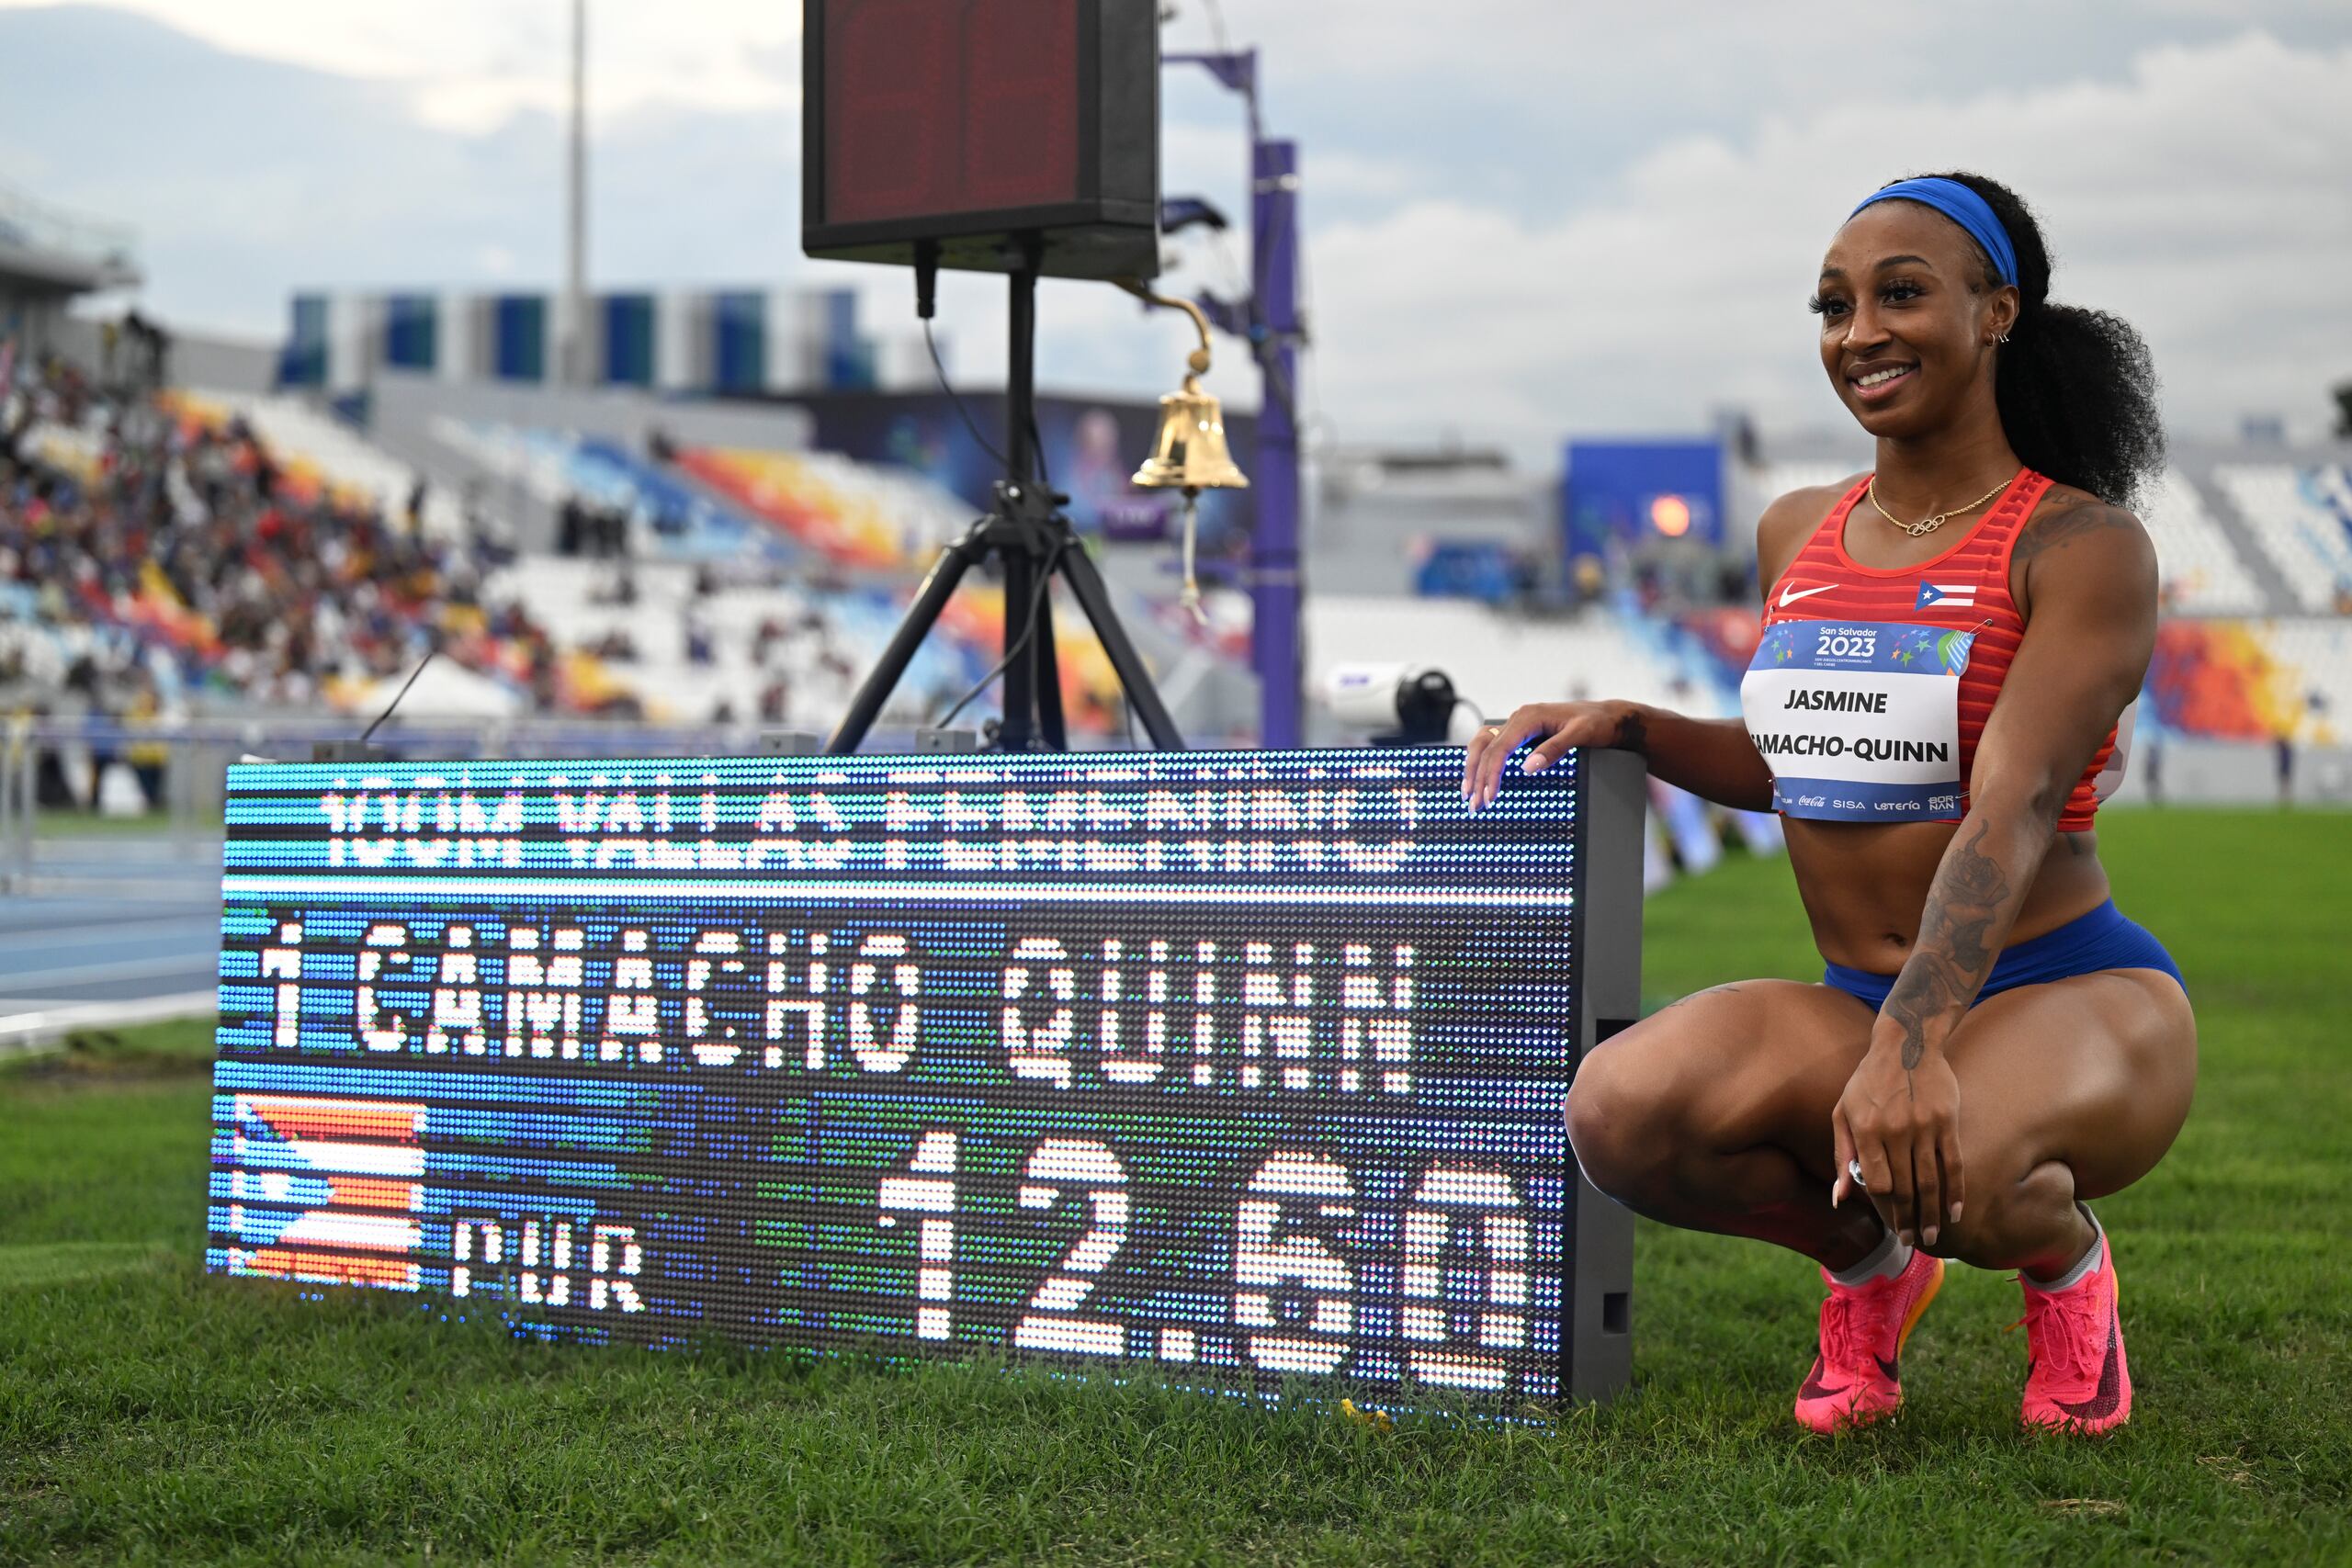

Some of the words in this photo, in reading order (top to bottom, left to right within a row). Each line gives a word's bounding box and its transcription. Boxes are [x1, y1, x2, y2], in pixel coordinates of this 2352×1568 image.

[1820, 626, 1837, 635] San
[1838, 627, 1877, 637] Salvador
[1816, 636, 1876, 657] 2023
[1784, 689, 1888, 714] JASMINE
[1751, 733, 1949, 762] AMACHO-QUINN
[1833, 799, 1866, 809] SISA
[1929, 795, 1954, 804] BOR
[551, 773, 852, 871] VALLAS
[262, 922, 302, 1048] 1
[356, 924, 919, 1074] CAMACHO
[1001, 937, 1416, 1095] QUINN
[452, 1219, 645, 1313] PUR
[878, 1131, 1529, 1392] 12.60
